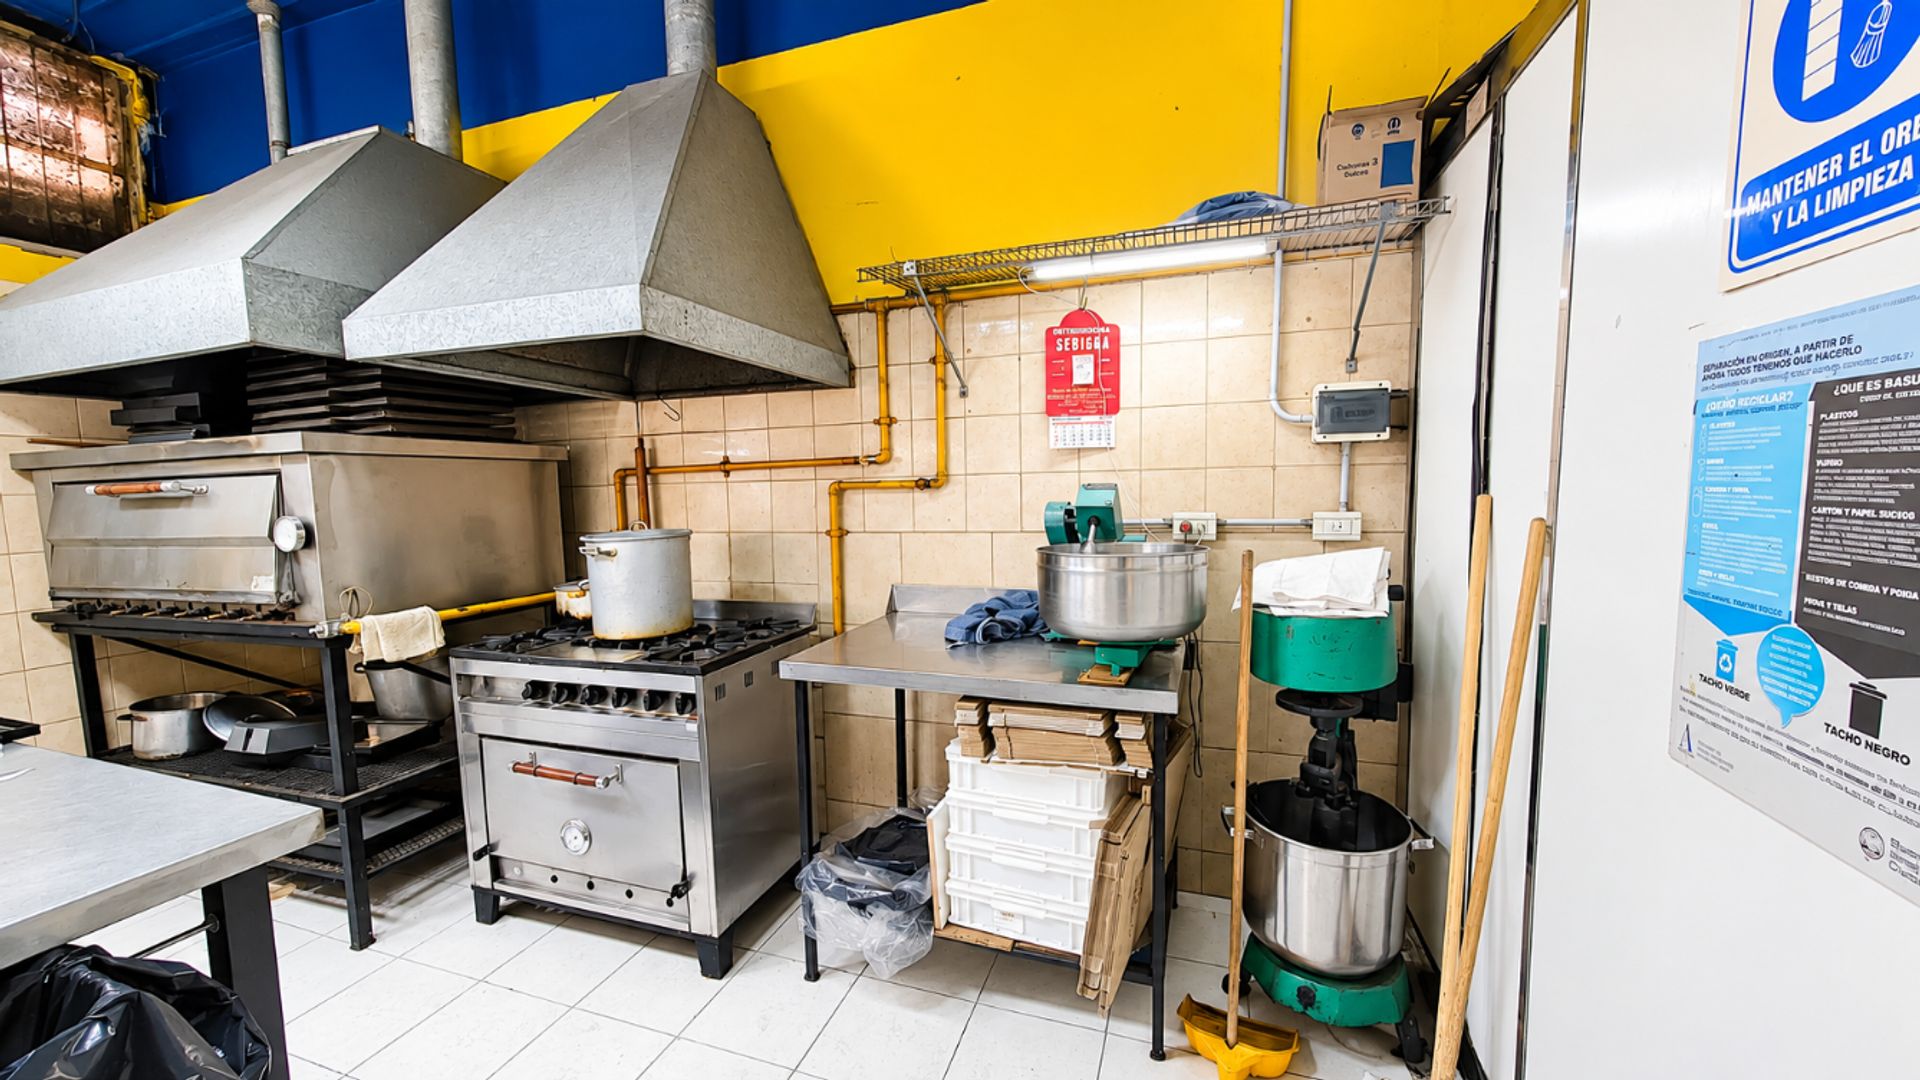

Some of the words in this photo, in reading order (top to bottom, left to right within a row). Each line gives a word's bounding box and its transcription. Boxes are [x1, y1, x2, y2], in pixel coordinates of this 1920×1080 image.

[1746, 153, 1843, 217] MANTENER
[1848, 139, 1874, 171] EL
[1771, 212, 1784, 235] Y
[1786, 201, 1809, 230] LA
[1813, 154, 1914, 218] LIMPIEZA
[1793, 354, 1814, 365] QUE
[1815, 344, 1862, 361] HACERLO
[1803, 338, 1837, 352] PARTIR
[1839, 334, 1854, 345] DE
[1866, 380, 1881, 391] ES
[1884, 373, 1920, 389] BASU
[1881, 586, 1889, 595] Y
[1698, 673, 1723, 692] TACHO
[1724, 682, 1751, 702] VERDE
[1824, 722, 1862, 747] TACHO
[1864, 740, 1911, 767] NEGRO
